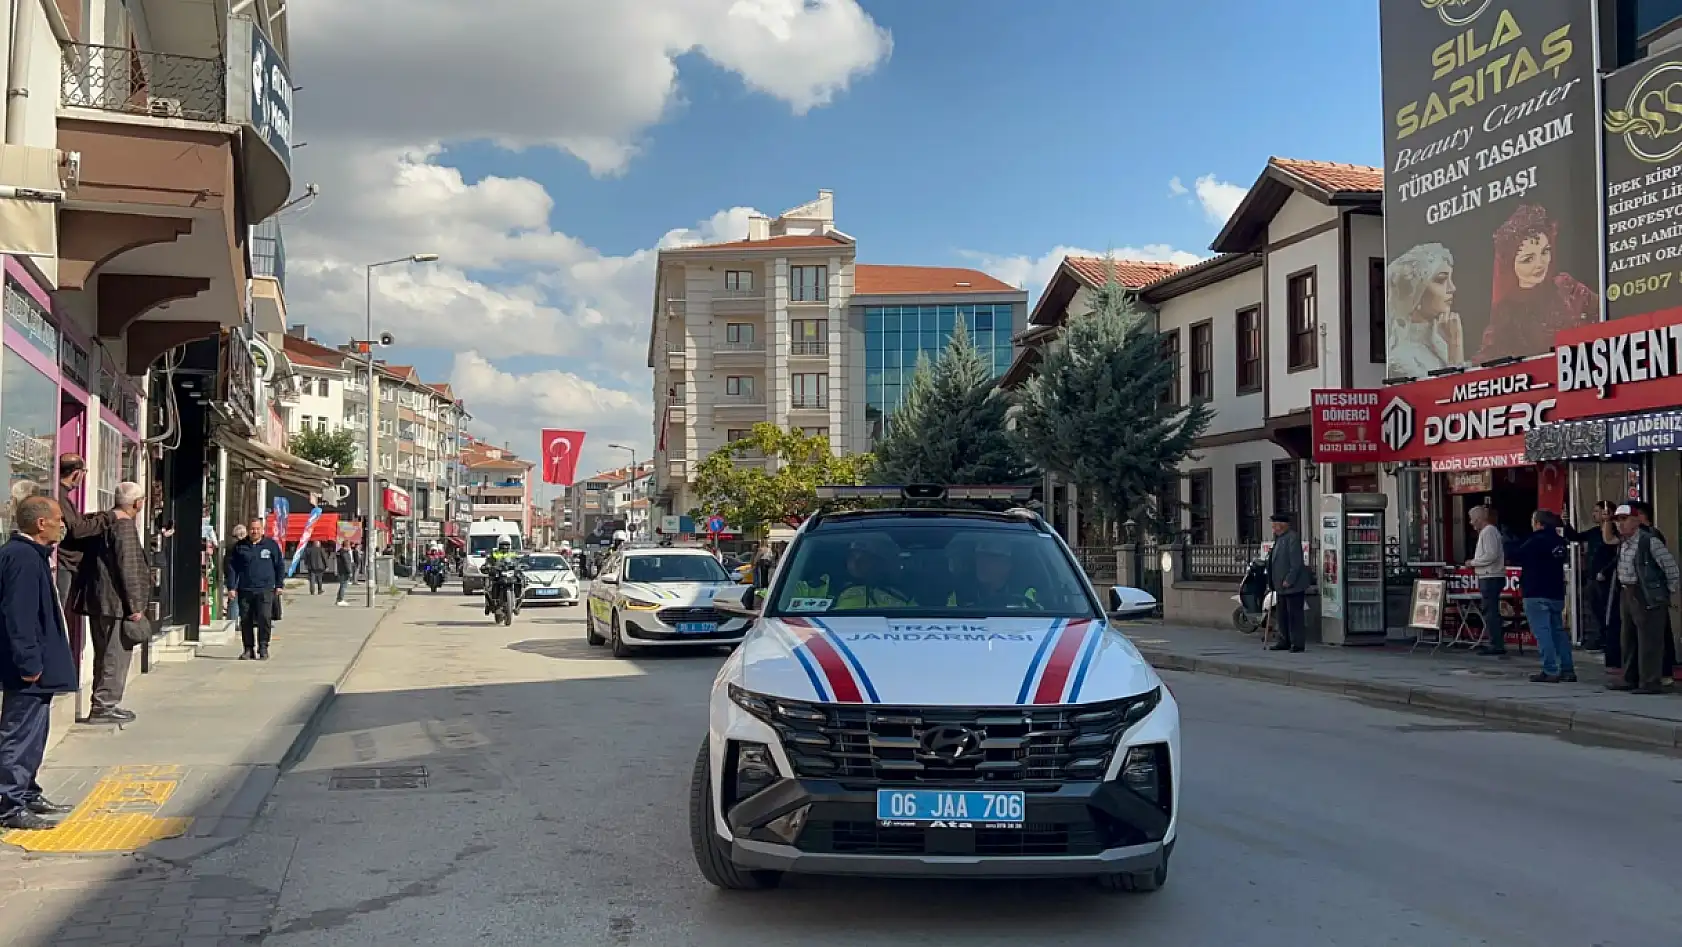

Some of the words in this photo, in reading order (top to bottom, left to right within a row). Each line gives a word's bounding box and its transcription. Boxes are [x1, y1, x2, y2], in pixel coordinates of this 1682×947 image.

[1431, 9, 1522, 80] SILA
[1396, 24, 1573, 140] SARITAŞ
[1392, 125, 1474, 174] Beauty
[1483, 78, 1580, 132] Center
[1398, 157, 1471, 203] TÜRBAN
[1475, 113, 1574, 172] TASARIM
[1608, 182, 1641, 198] İPEK
[1645, 166, 1682, 186] KİRP
[1426, 184, 1482, 225] GELİN
[1488, 166, 1538, 204] BAŞI
[1608, 191, 1659, 216] KİRPİK
[1609, 237, 1638, 254] KAŞ
[1609, 252, 1652, 273] ALTIN
[1623, 272, 1672, 296] 0507
[1557, 324, 1682, 400] BAŞKENT
[1315, 392, 1378, 407] MEŞHUR
[1322, 406, 1370, 421] DÖNERCİ
[1432, 457, 1462, 471] KADİR
[846, 632, 1034, 642] JANDARMASI
[891, 793, 917, 816] 06
[931, 794, 968, 818] JAA
[983, 794, 1021, 818] 706
